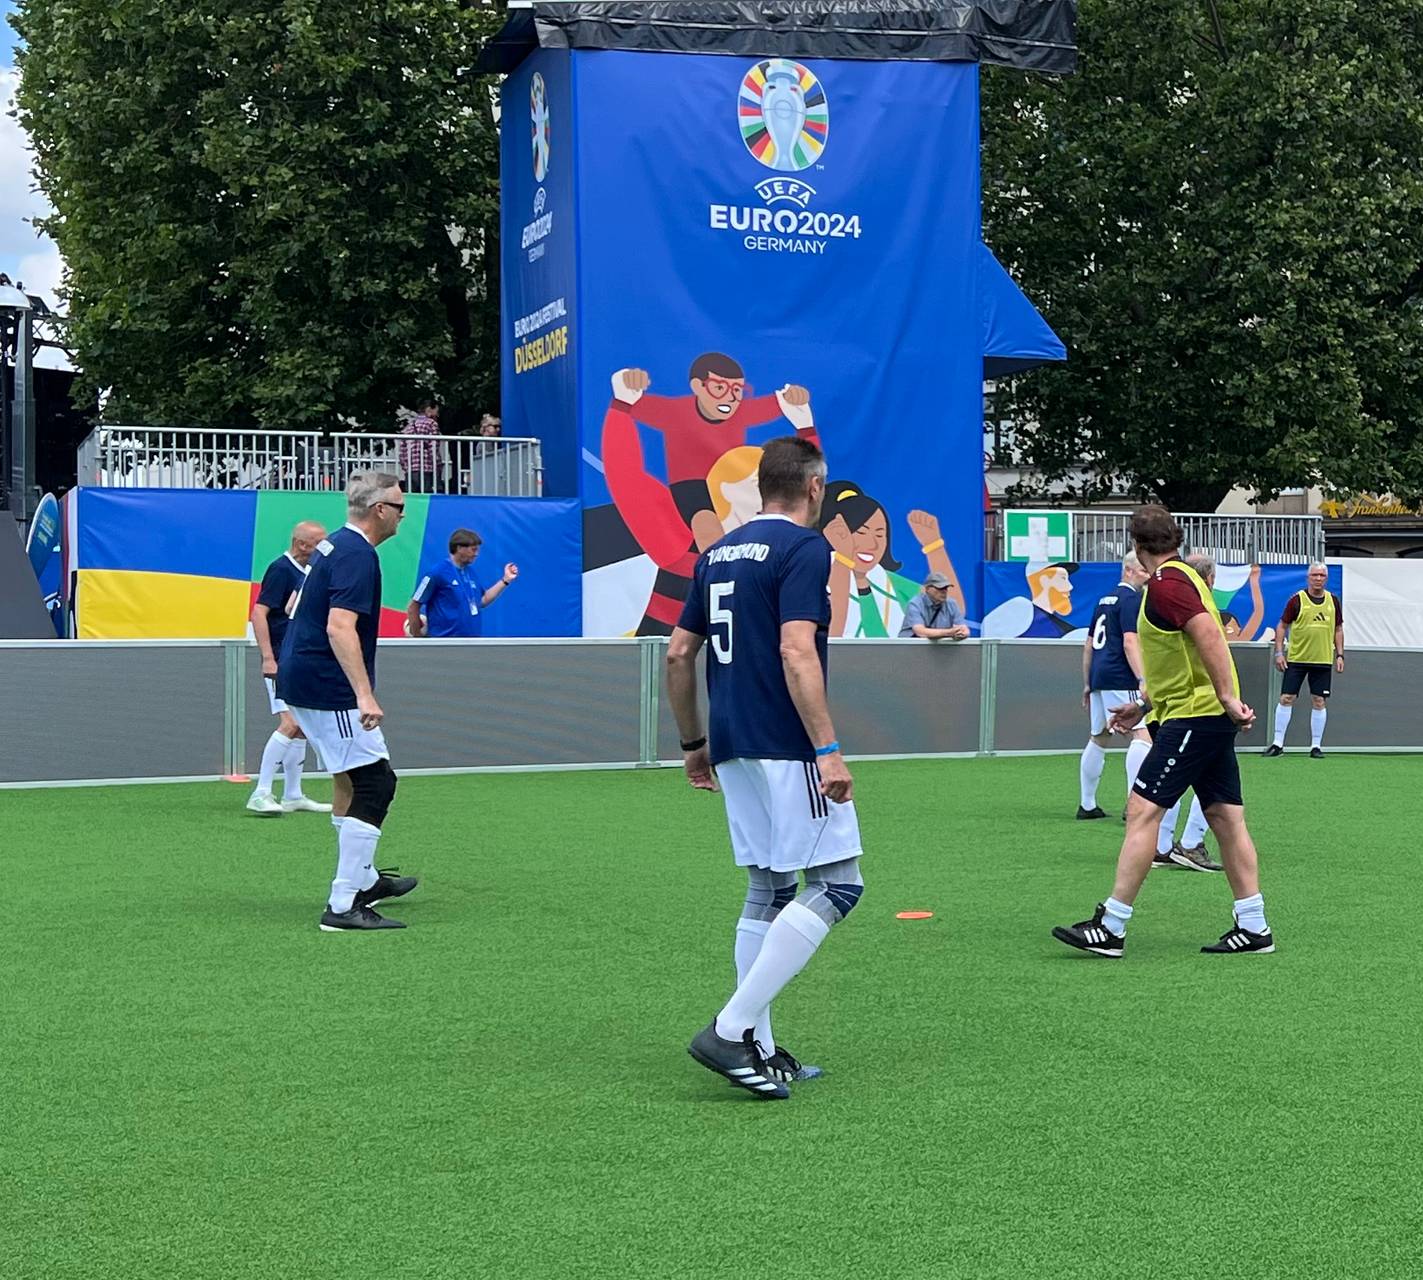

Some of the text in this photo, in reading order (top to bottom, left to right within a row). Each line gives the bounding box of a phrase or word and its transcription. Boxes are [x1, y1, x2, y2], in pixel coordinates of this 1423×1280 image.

[757, 181, 811, 205] UEFA
[710, 204, 862, 239] EURO2024
[743, 235, 827, 255] GERMANY
[514, 325, 568, 375] DÜSSELDORF
[709, 580, 735, 665] 5
[1092, 613, 1107, 651] 6
